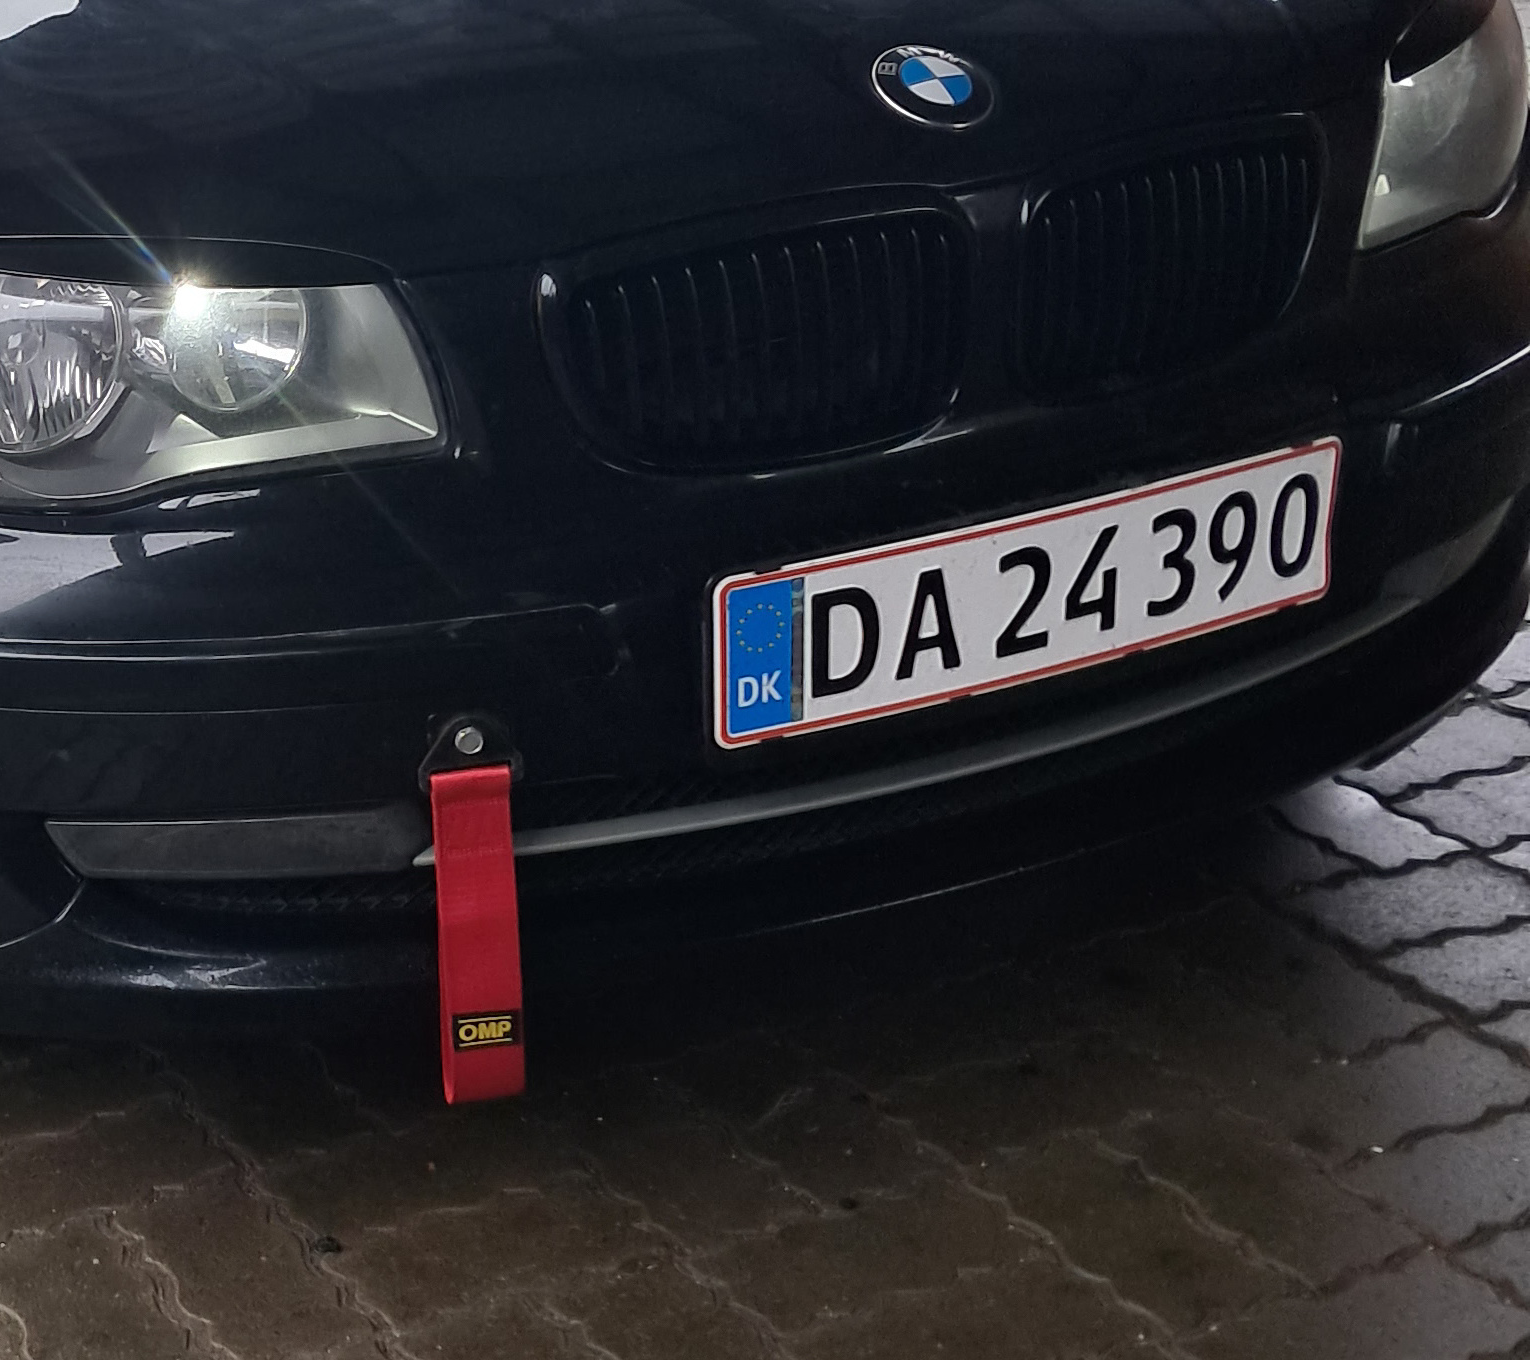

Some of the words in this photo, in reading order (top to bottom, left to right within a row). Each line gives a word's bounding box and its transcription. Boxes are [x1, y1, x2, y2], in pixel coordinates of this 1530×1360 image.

[877, 46, 960, 77] BMW
[810, 567, 962, 699] DA
[994, 524, 1120, 659] 24
[1146, 472, 1319, 618] 390
[736, 669, 782, 709] DK
[458, 1020, 512, 1041] OMP
